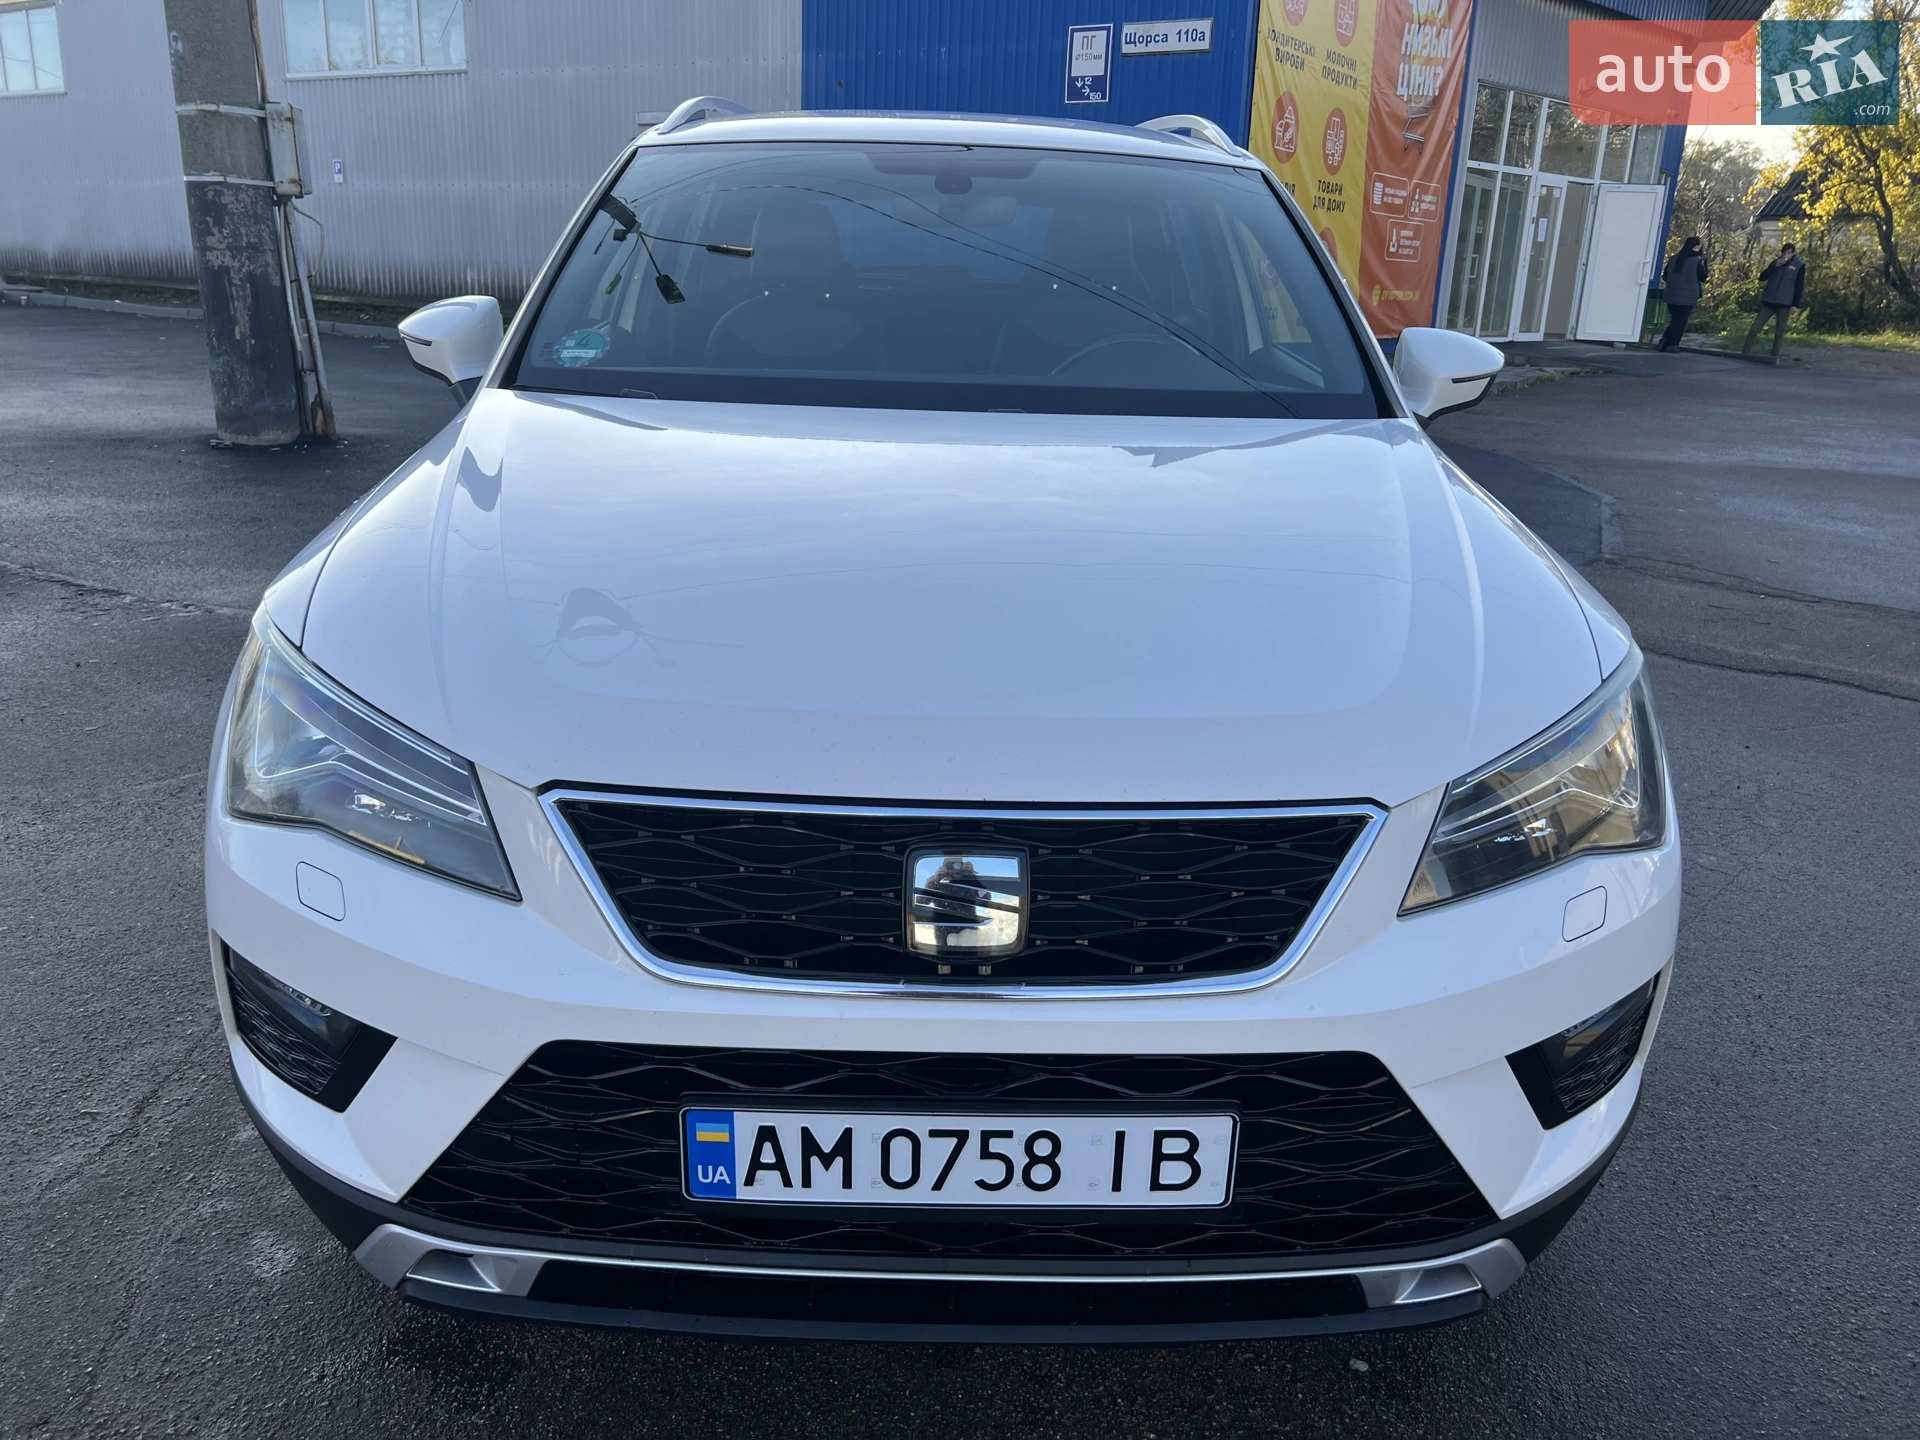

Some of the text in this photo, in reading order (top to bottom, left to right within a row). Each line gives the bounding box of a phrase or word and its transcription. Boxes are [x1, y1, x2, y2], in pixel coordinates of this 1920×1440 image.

[1081, 35, 1096, 50] ПГ
[1124, 28, 1206, 47] Щорса 110а
[1267, 27, 1316, 58] КОНДИТЕРСЬКІ
[1401, 22, 1454, 59] НИЗЬКІ
[1275, 47, 1305, 71] ВИРОБИ
[1326, 48, 1357, 72] МОЛОЧНІ
[1322, 65, 1358, 90] ПРОДУКТИ
[1396, 62, 1444, 102] ЦІНИ?
[1089, 91, 1101, 100] 150
[1317, 179, 1343, 196] ТОВАРИ
[1313, 196, 1347, 214] ДЛЯ ДОМУ
[697, 1125, 1202, 1193] UA AM 0758 IB
